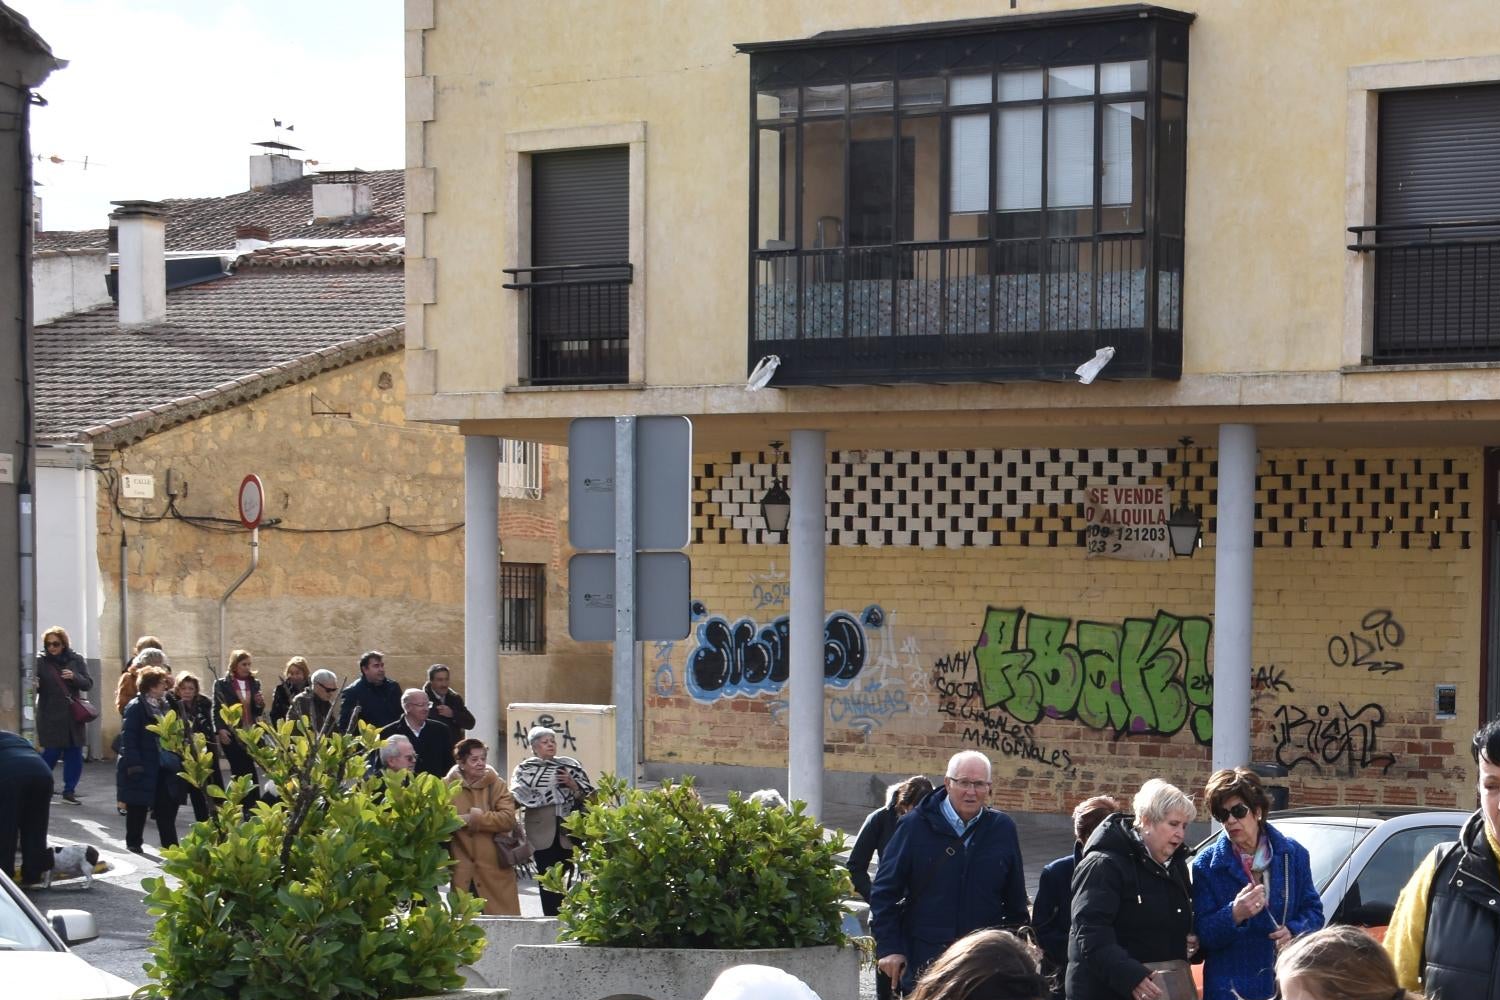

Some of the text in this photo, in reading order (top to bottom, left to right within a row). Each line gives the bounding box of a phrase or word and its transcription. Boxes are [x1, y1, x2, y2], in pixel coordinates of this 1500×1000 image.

[1091, 488, 1164, 504] SE VENDE
[1086, 507, 1167, 526] O ALQUILA
[1117, 527, 1165, 541] 121203
